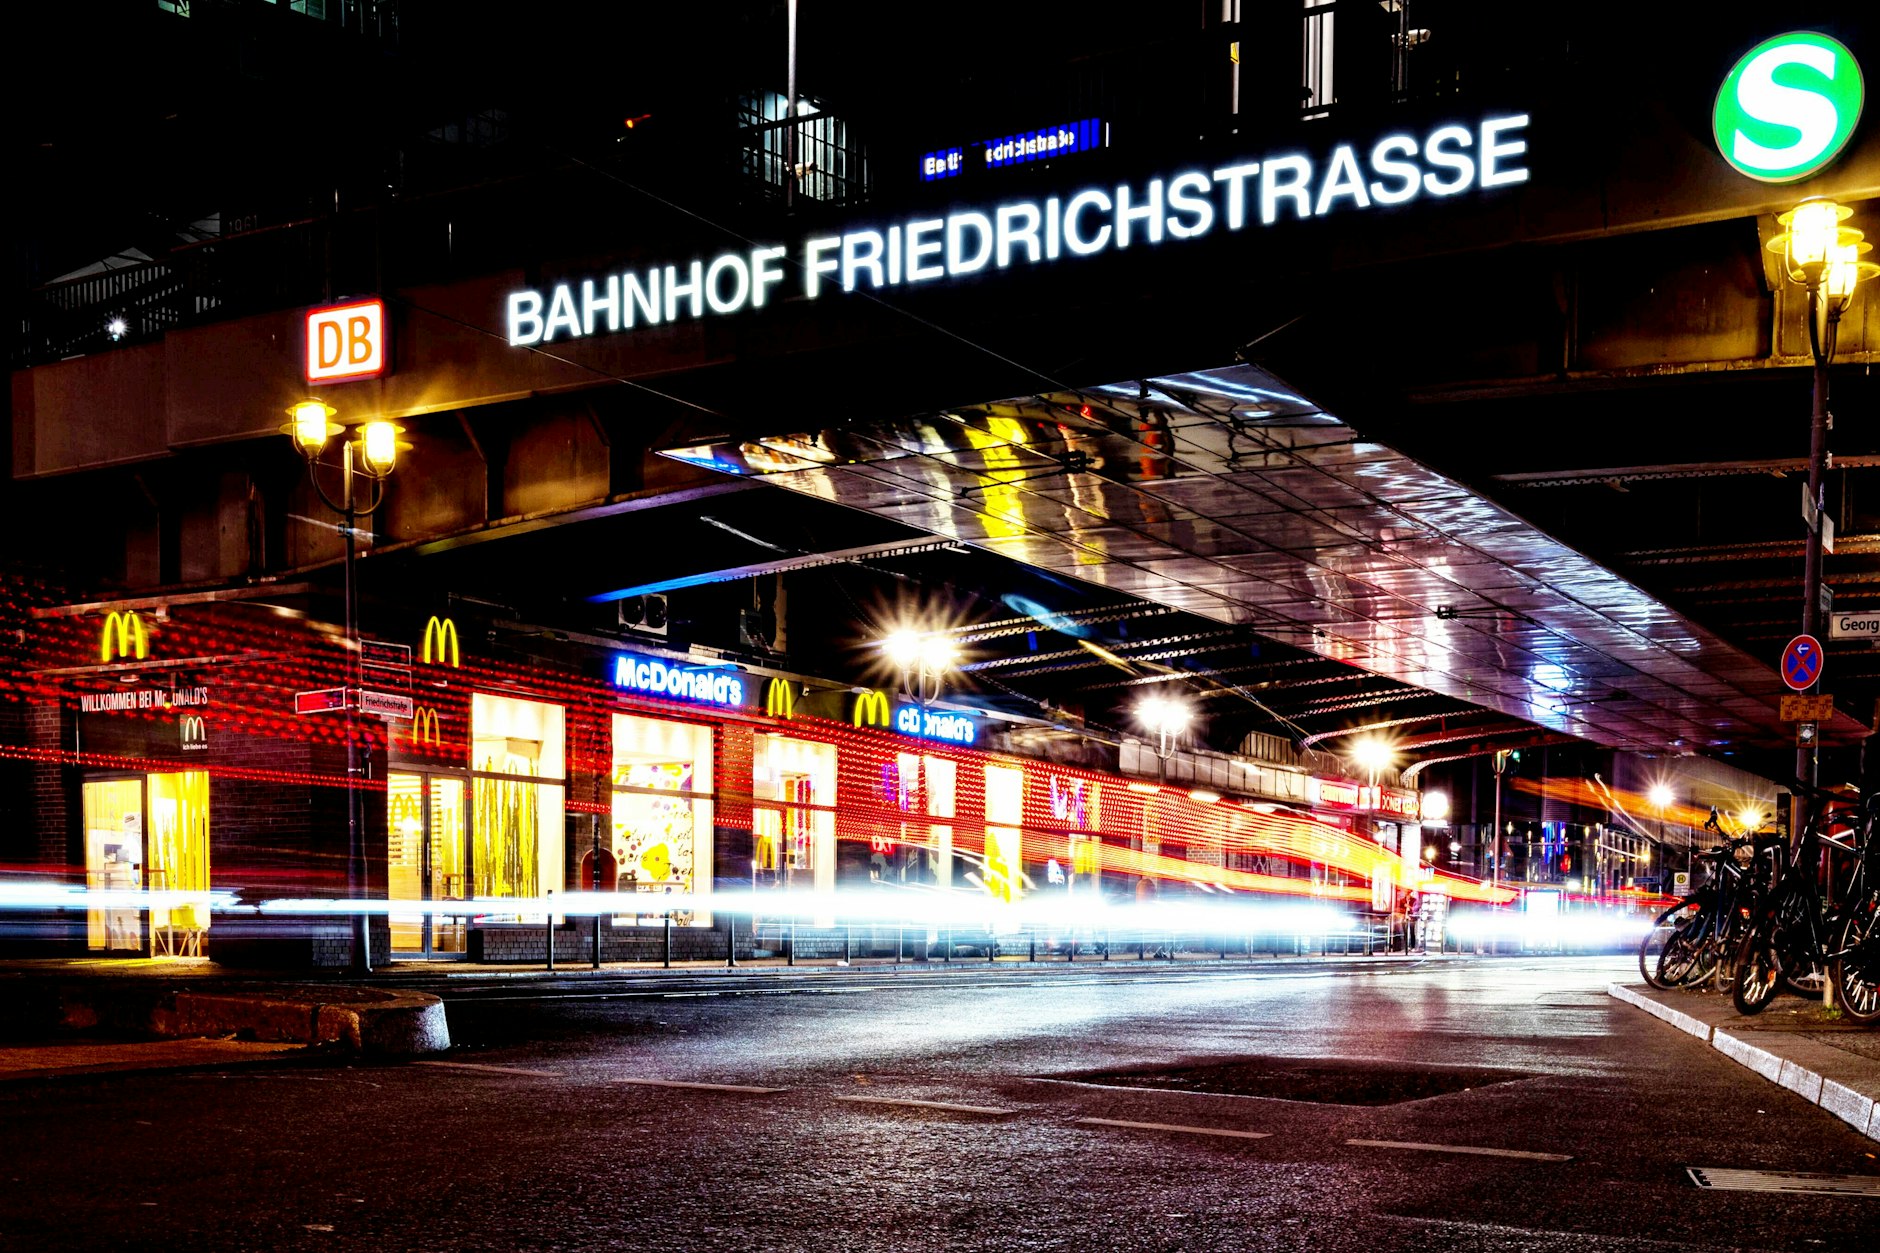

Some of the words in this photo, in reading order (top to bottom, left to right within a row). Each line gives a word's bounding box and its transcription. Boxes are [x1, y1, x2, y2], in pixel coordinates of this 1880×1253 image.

[1733, 43, 1838, 170] S
[504, 243, 788, 348] BAHNHOF
[802, 111, 1532, 299] FRIEDRICHSTRASSE
[318, 315, 373, 370] DB
[1840, 617, 1880, 634] Georg
[81, 692, 136, 712] WILLKOMMEN
[139, 690, 152, 709] BEI
[615, 656, 743, 706] McDonald's
